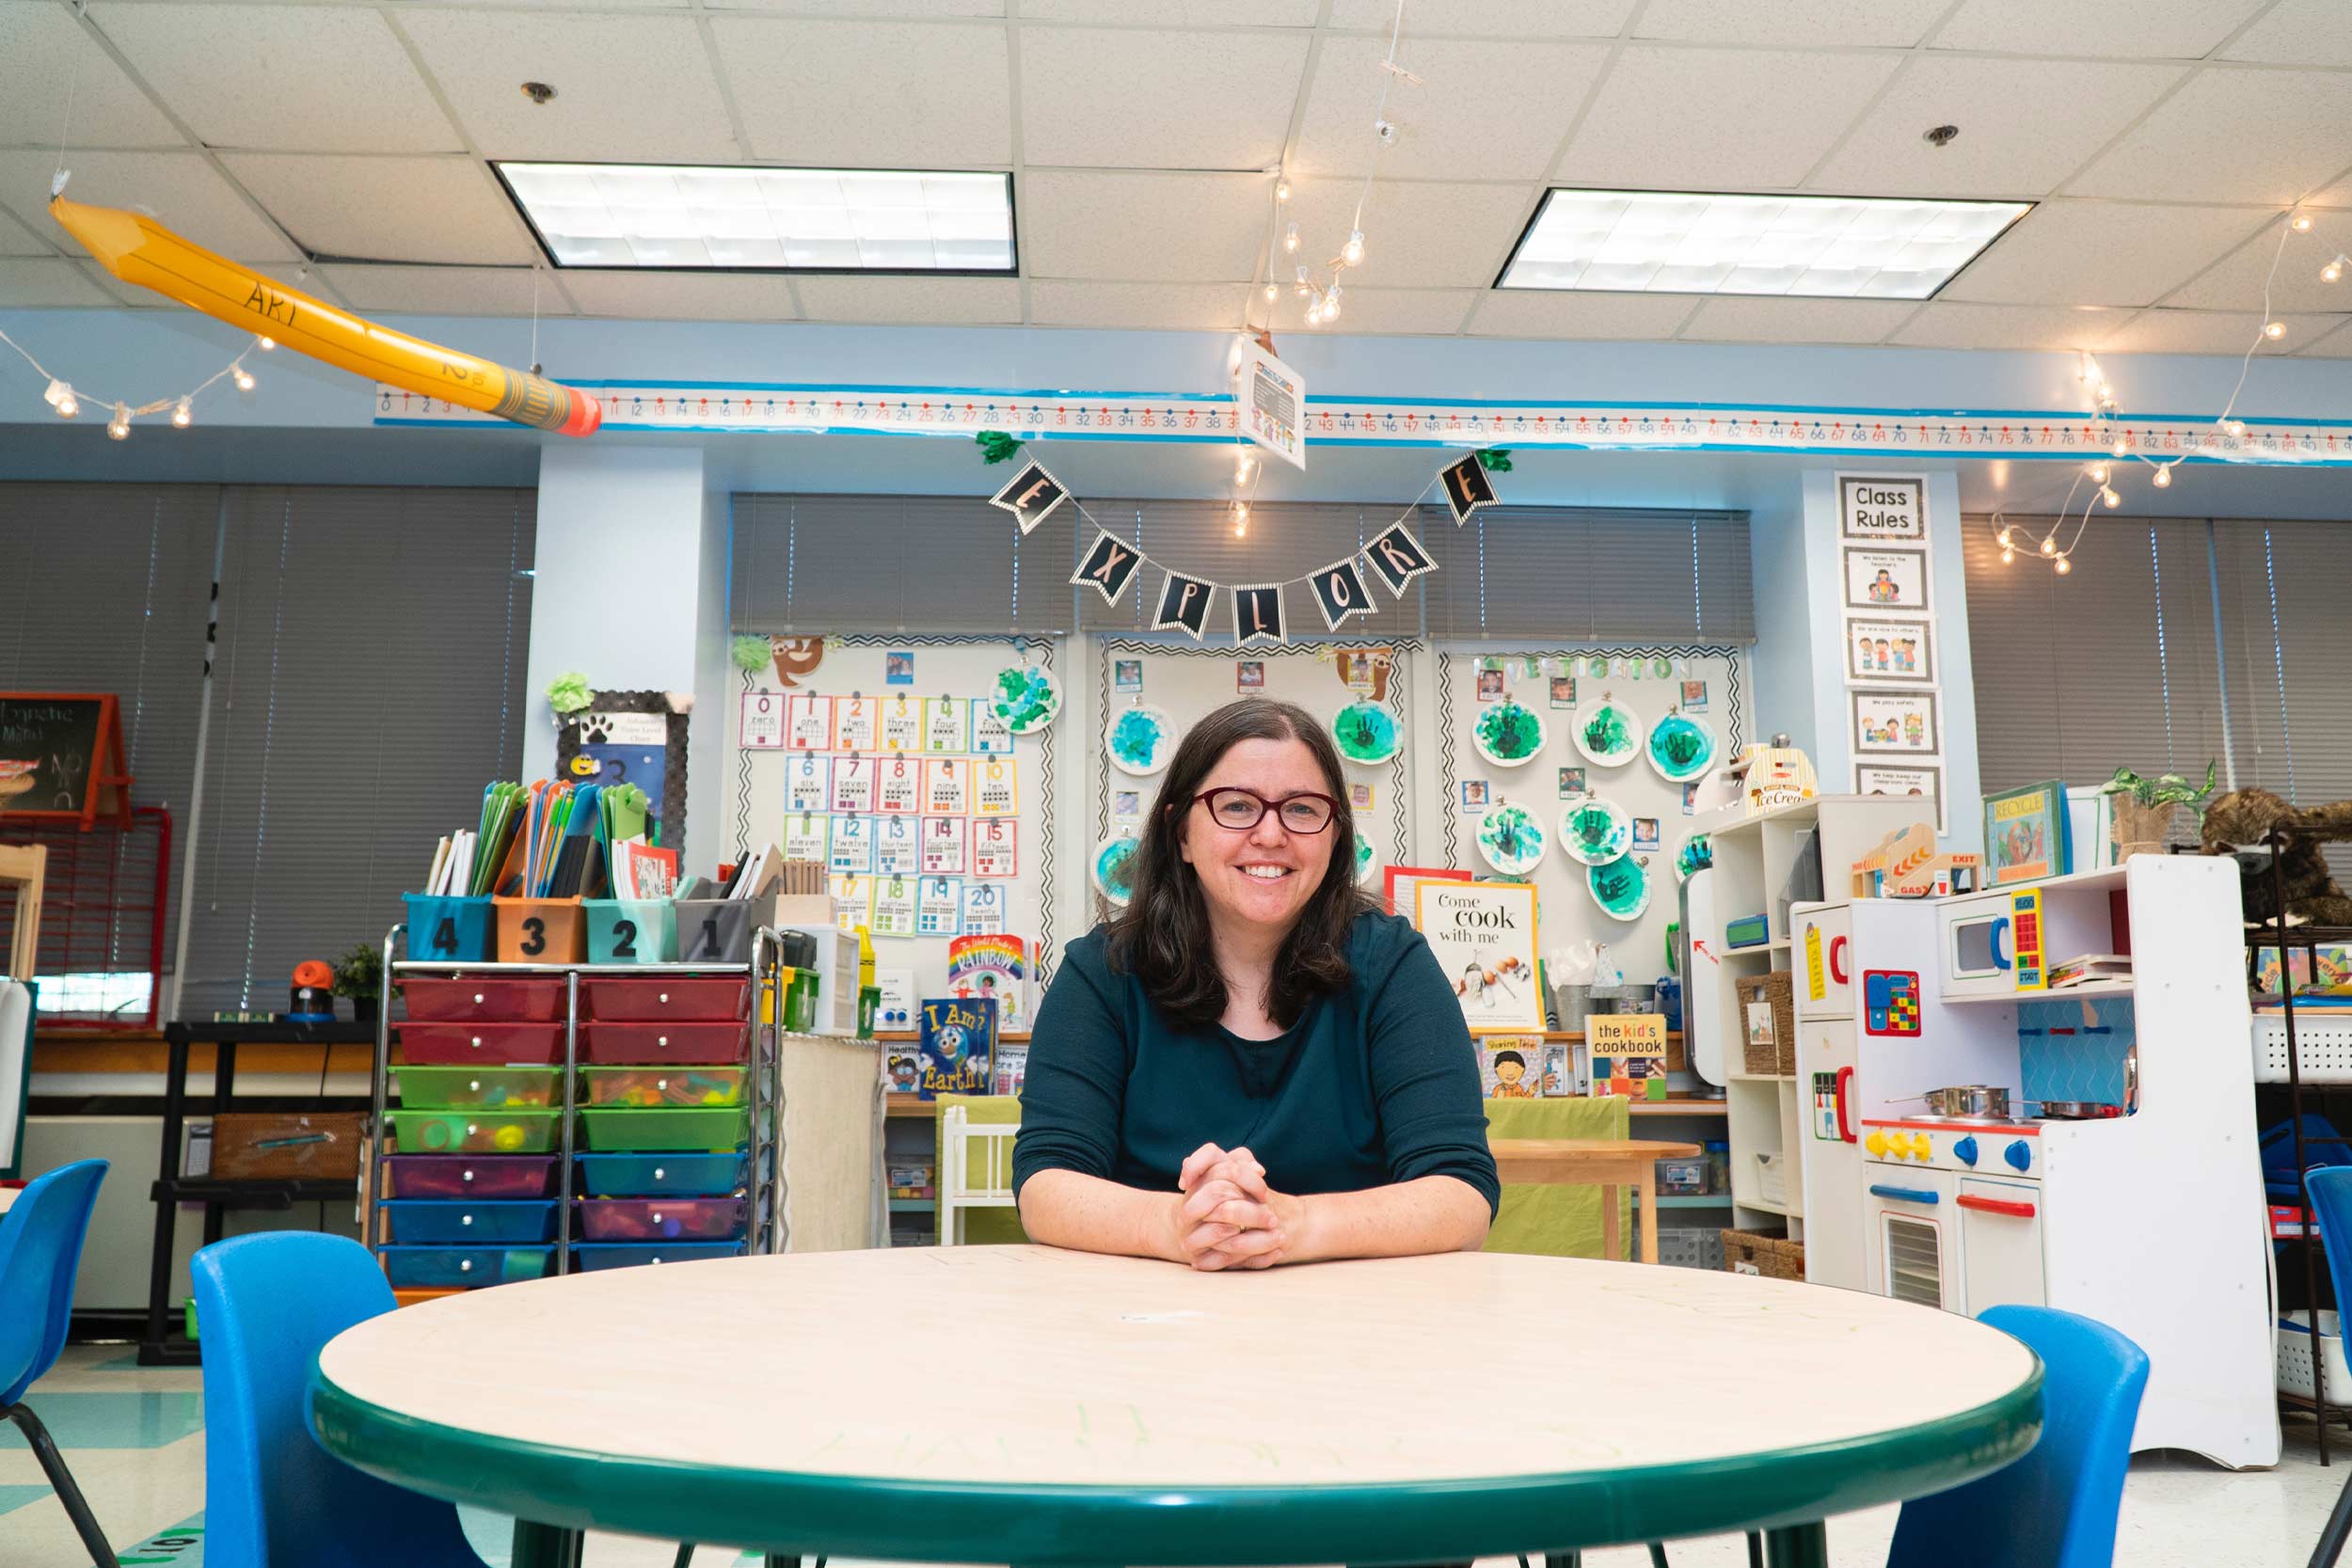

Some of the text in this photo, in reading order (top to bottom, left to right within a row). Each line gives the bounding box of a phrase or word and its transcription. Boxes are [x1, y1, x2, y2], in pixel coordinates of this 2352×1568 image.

[380, 400, 392, 411] 0
[422, 401, 432, 412] 2
[611, 404, 620, 416] 11
[631, 404, 644, 416] 12
[654, 404, 666, 416] 13
[675, 405, 688, 417] 14
[697, 405, 710, 417] 15
[719, 405, 731, 417] 16
[741, 406, 754, 418] 17
[875, 409, 891, 420] 23
[896, 409, 913, 420] 24
[917, 409, 934, 420] 25
[940, 410, 956, 421] 26
[962, 411, 977, 422] 27
[983, 411, 1000, 422] 28
[1006, 412, 1022, 423] 29
[1026, 413, 1044, 424] 30
[1056, 413, 1068, 424] 31
[1075, 414, 1090, 425] 32
[1096, 415, 1113, 426] 33
[1118, 415, 1135, 426] 34
[1139, 416, 1156, 427] 35
[1161, 416, 1178, 427] 36
[1184, 417, 1200, 428] 37
[1204, 418, 1222, 429] 38
[1317, 420, 1334, 431] 43
[1339, 420, 1356, 432] 44
[1359, 420, 1377, 432] 45
[1381, 421, 1399, 433] 46
[1403, 421, 1420, 433] 47
[1423, 422, 1441, 434] 48
[1445, 422, 1462, 434] 49
[1467, 423, 1485, 435] 50
[1534, 423, 1549, 435] 53
[1575, 424, 1592, 436] 55
[1597, 424, 1613, 436] 56
[1617, 424, 1633, 436] 57
[1638, 424, 1656, 436] 58
[1660, 424, 1676, 436] 59
[1680, 425, 1698, 436] 60
[1708, 426, 1720, 437] 61
[1727, 426, 1741, 437] 62
[1748, 427, 1763, 438] 63
[1769, 428, 1784, 439] 64
[1788, 428, 1805, 439] 65
[1809, 429, 1826, 440] 66
[1831, 430, 1846, 441] 67
[1851, 430, 1867, 441] 68
[1871, 431, 1886, 442] 69
[1892, 432, 1908, 443] 70
[1918, 433, 1931, 444] 71
[1937, 433, 1952, 444] 72
[1957, 433, 1973, 444] 73
[1978, 433, 1994, 444] 74
[1997, 434, 2014, 445] 75
[2020, 434, 2033, 445] 76
[2040, 434, 2054, 445] 77
[2061, 434, 2075, 445] 78
[2081, 435, 2096, 446] 79
[2143, 437, 2159, 449] 82
[2163, 437, 2180, 449] 83
[2223, 439, 2240, 451] 86
[2280, 441, 2297, 452] 89
[2301, 441, 2318, 452] 90
[2327, 442, 2338, 453] 91
[1856, 487, 1907, 506] Class
[1856, 510, 1909, 529] Rules
[758, 697, 770, 713] 0
[807, 698, 814, 716] 1
[850, 700, 862, 718] 2
[897, 700, 908, 718] 3
[940, 701, 952, 718] 4
[752, 716, 775, 724] zero
[801, 718, 819, 726] one
[847, 719, 866, 727] two
[887, 718, 915, 727] three
[935, 719, 957, 729] four
[802, 761, 814, 777] 6
[849, 761, 860, 778] 7
[893, 762, 905, 779] 8
[942, 763, 954, 781] 9
[986, 764, 1004, 781] 10
[801, 779, 815, 787] six
[838, 780, 867, 788] seven
[887, 780, 912, 789] eight
[936, 783, 957, 791] nine
[987, 783, 1005, 791] ten
[802, 819, 810, 836] 11
[843, 819, 860, 837] 12
[888, 821, 905, 839] 13
[935, 821, 952, 838] 14
[987, 825, 1003, 841] 15
[789, 838, 822, 847] eleven
[834, 839, 869, 848] twelve
[1952, 855, 1976, 863] EXIT
[842, 880, 858, 897] 17
[888, 881, 903, 898] 18
[931, 881, 948, 898] 19
[1899, 886, 1922, 895] GAS
[971, 888, 995, 908] 20
[1438, 893, 1481, 909] Come
[1454, 905, 1518, 929] cook
[432, 917, 459, 955] 4
[520, 917, 547, 957] 3
[612, 920, 637, 958] 2
[702, 920, 722, 958] 1
[1439, 928, 1500, 944] with me
[956, 948, 1018, 973] RAINBOW
[2020, 972, 2039, 982] START
[924, 1004, 977, 1033] I Am
[1598, 1023, 1656, 1038] the kid's
[888, 1045, 920, 1055] Healthy
[998, 1049, 1026, 1059] Home
[1594, 1039, 1662, 1053] cookbook
[923, 1066, 977, 1090] Earth
